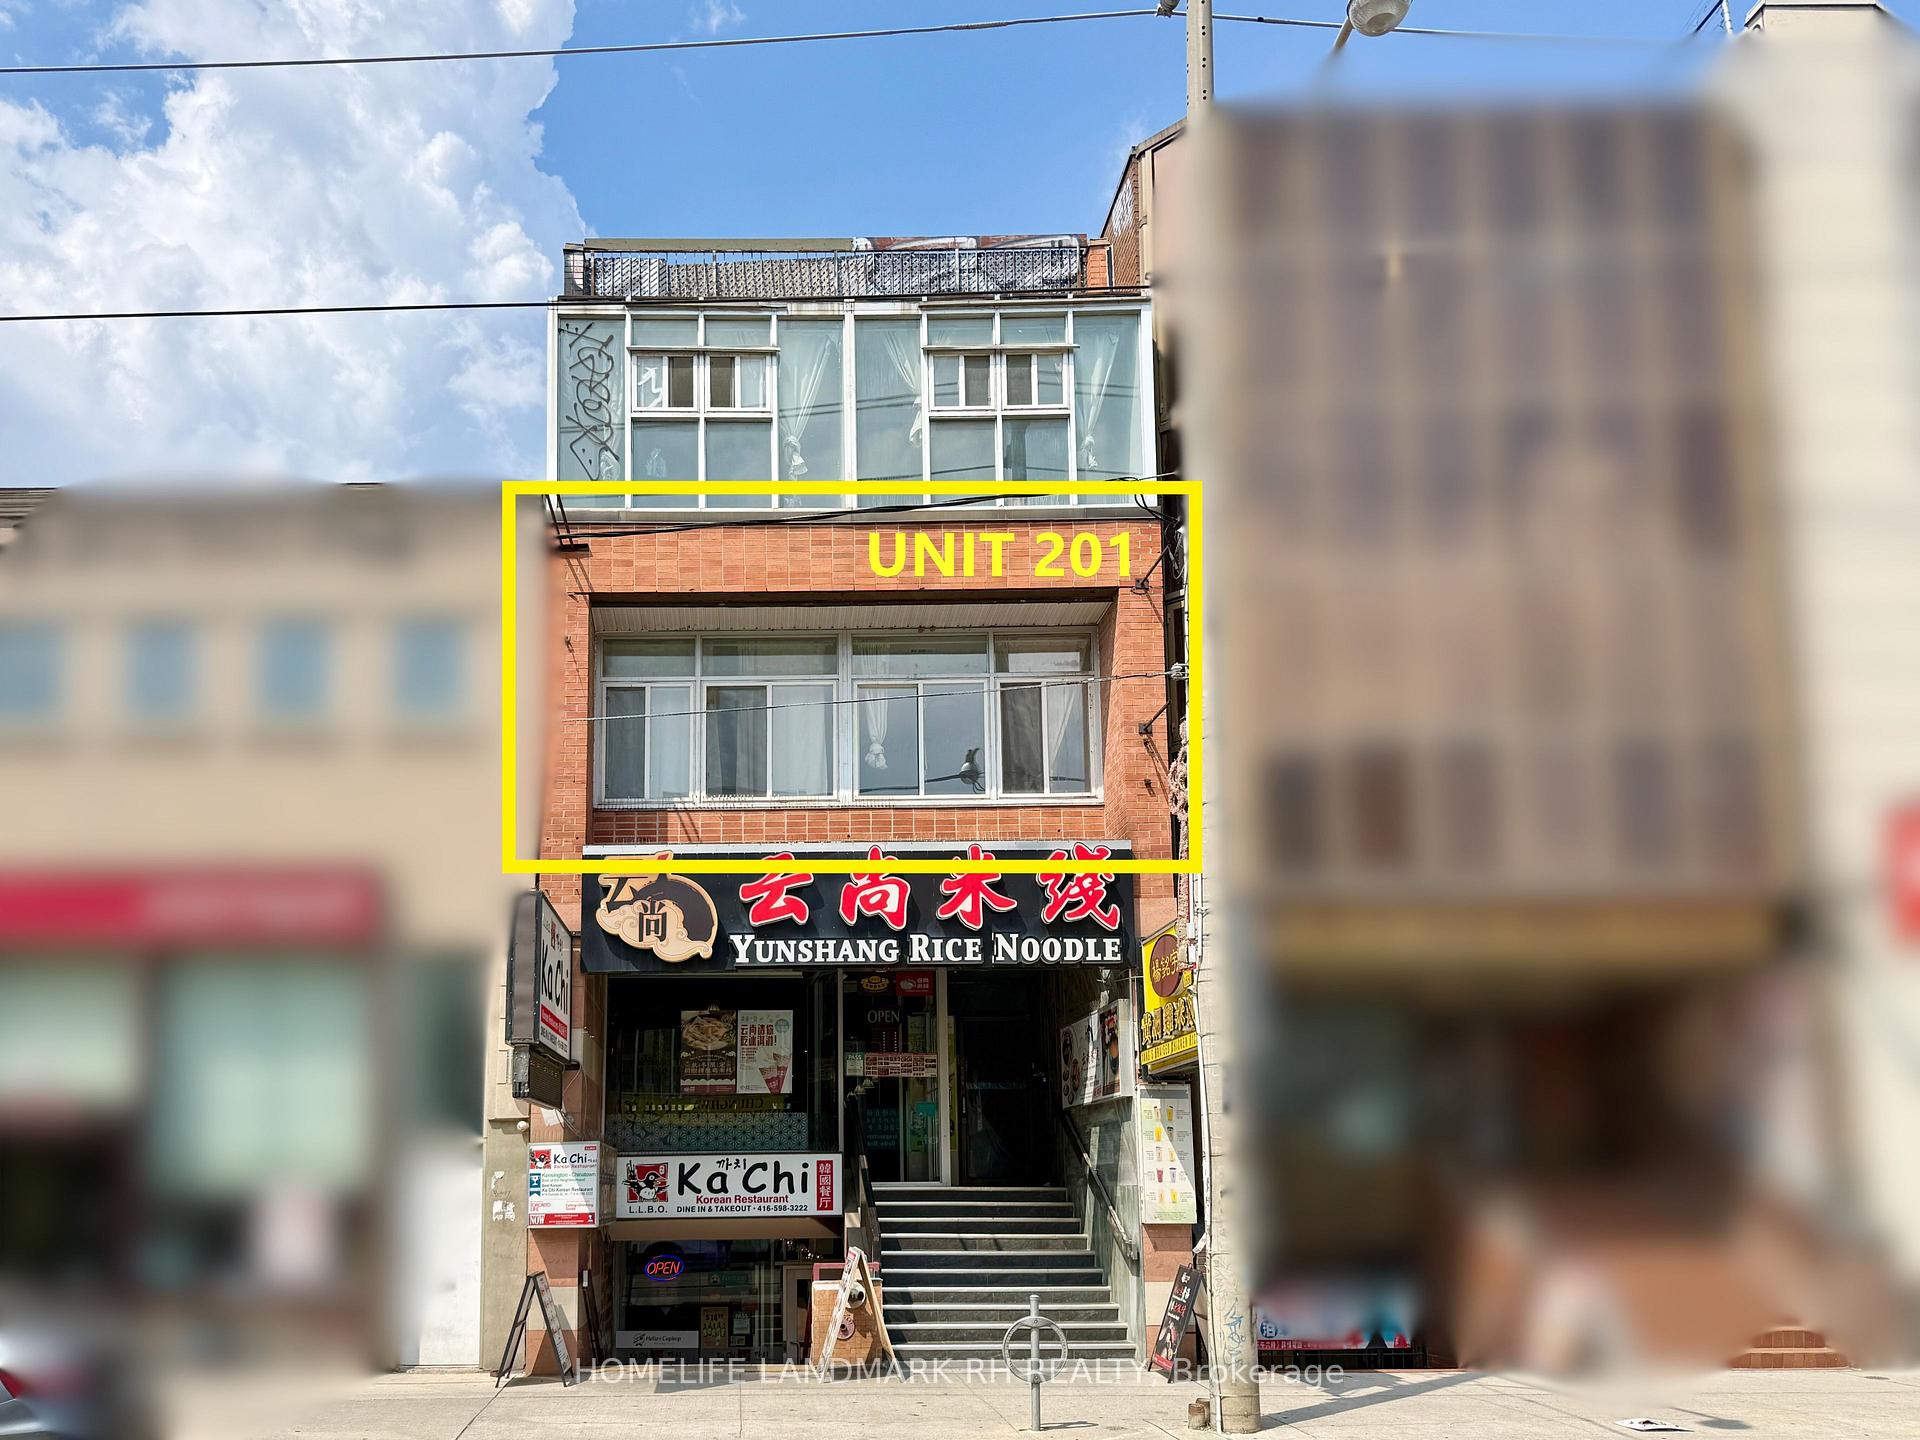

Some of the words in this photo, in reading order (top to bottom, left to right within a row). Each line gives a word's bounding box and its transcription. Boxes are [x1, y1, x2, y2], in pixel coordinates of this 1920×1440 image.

[909, 933, 982, 963] RICE
[993, 932, 1122, 963] NOODLE
[867, 1009, 900, 1024] OPEN
[553, 1154, 567, 1164] Ka
[569, 1153, 587, 1163] Chi
[695, 1194, 732, 1204] Korean
[734, 1194, 789, 1204] Restaurant
[628, 1205, 668, 1214] L.L.B.O.
[676, 1205, 696, 1213] DINE
[696, 1205, 706, 1213] IN
[714, 1204, 751, 1213] TAKEOUT
[756, 1204, 808, 1212] 416-598-3222
[530, 1215, 544, 1225] NOW
[646, 1260, 682, 1275] OPEN
